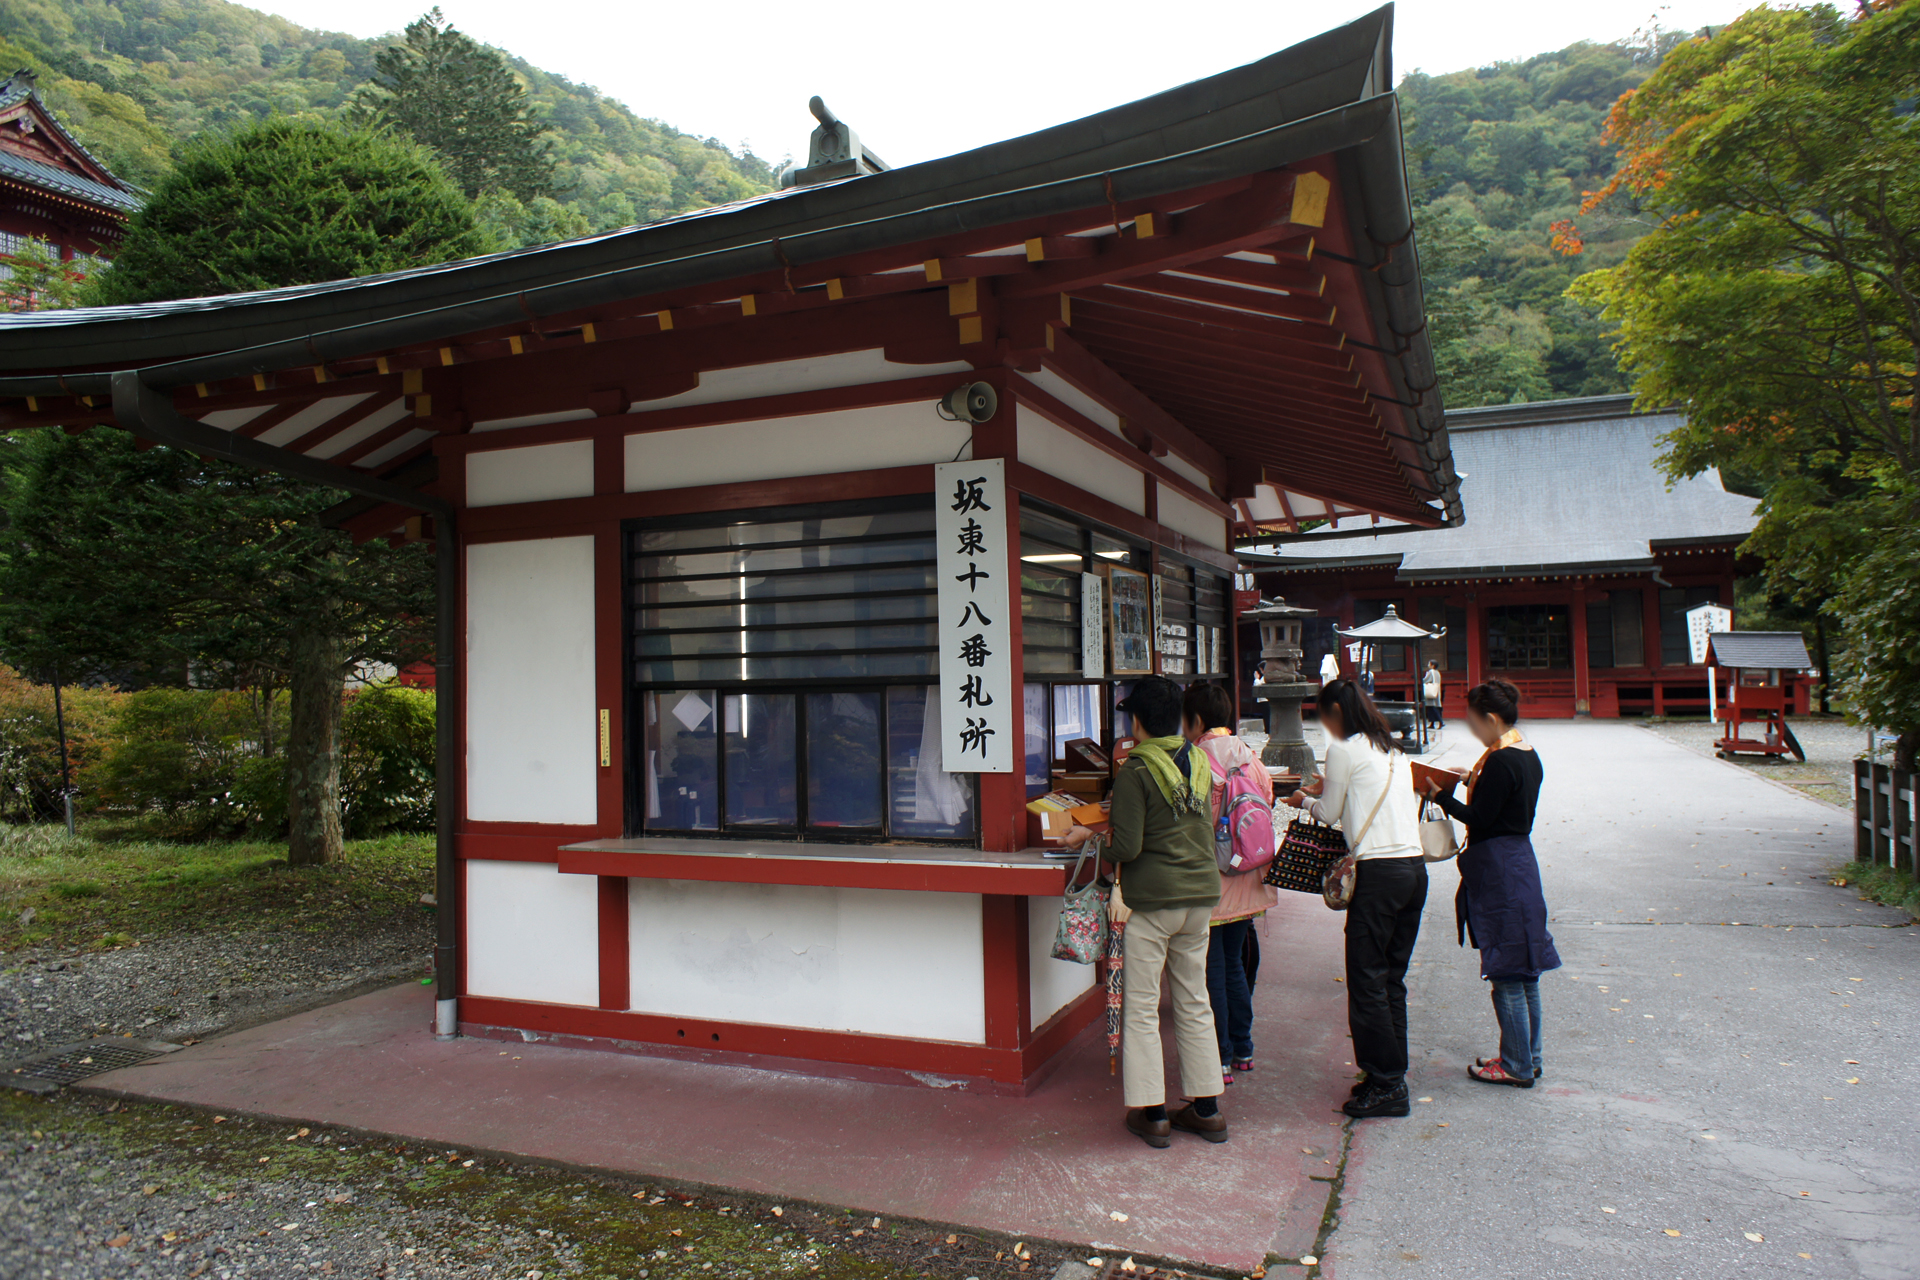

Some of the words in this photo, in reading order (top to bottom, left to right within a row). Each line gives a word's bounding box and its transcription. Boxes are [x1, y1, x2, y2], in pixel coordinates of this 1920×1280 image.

[951, 476, 996, 759] 坂東十八番札所
